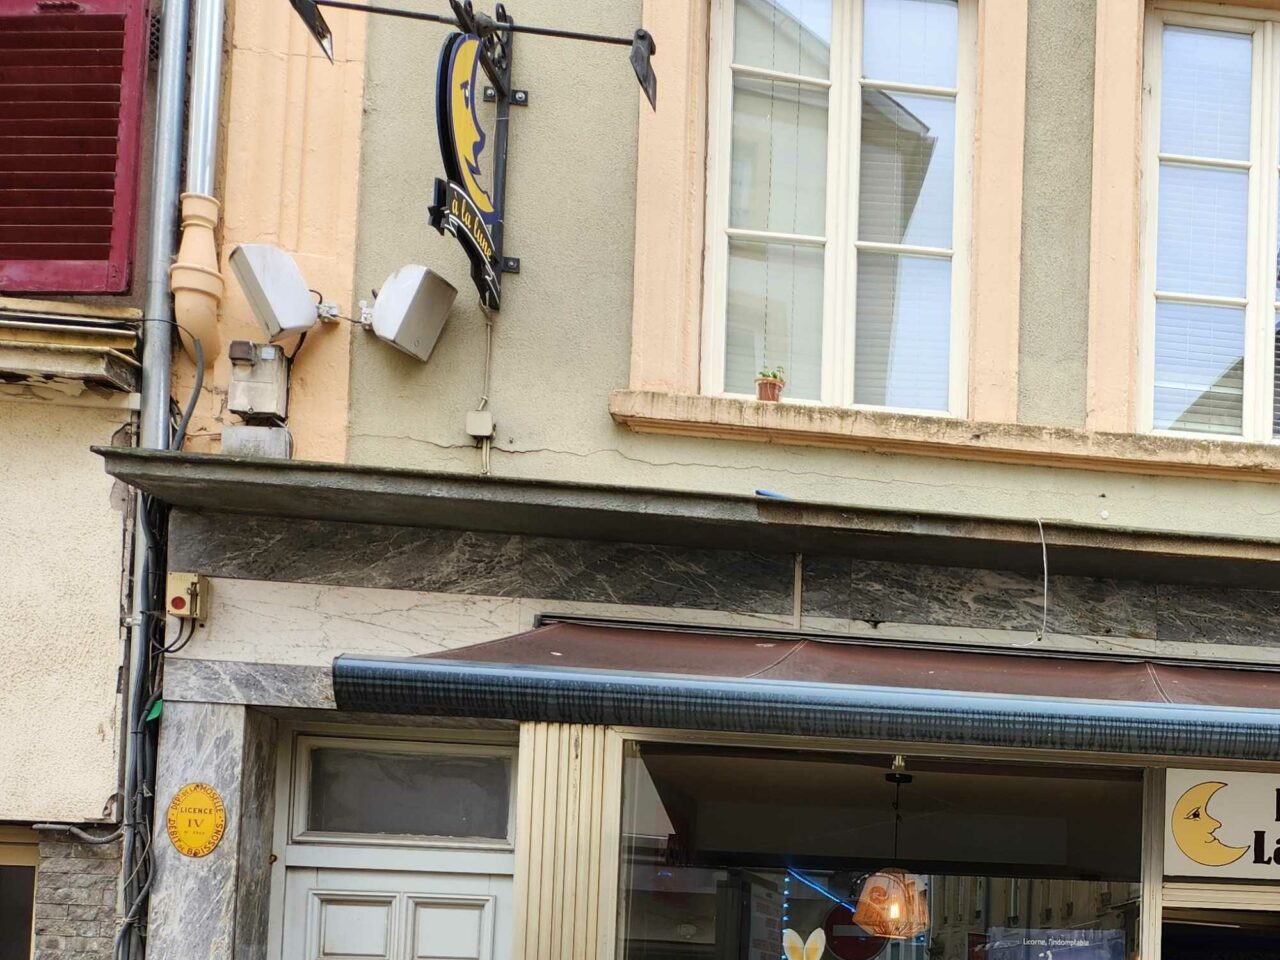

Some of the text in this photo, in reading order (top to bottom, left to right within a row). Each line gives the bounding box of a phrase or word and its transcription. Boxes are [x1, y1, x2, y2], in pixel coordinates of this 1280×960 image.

[452, 191, 492, 262] à la lune
[201, 784, 224, 814] MOSELLE
[180, 806, 214, 815] LICENCE
[188, 818, 205, 828] IV
